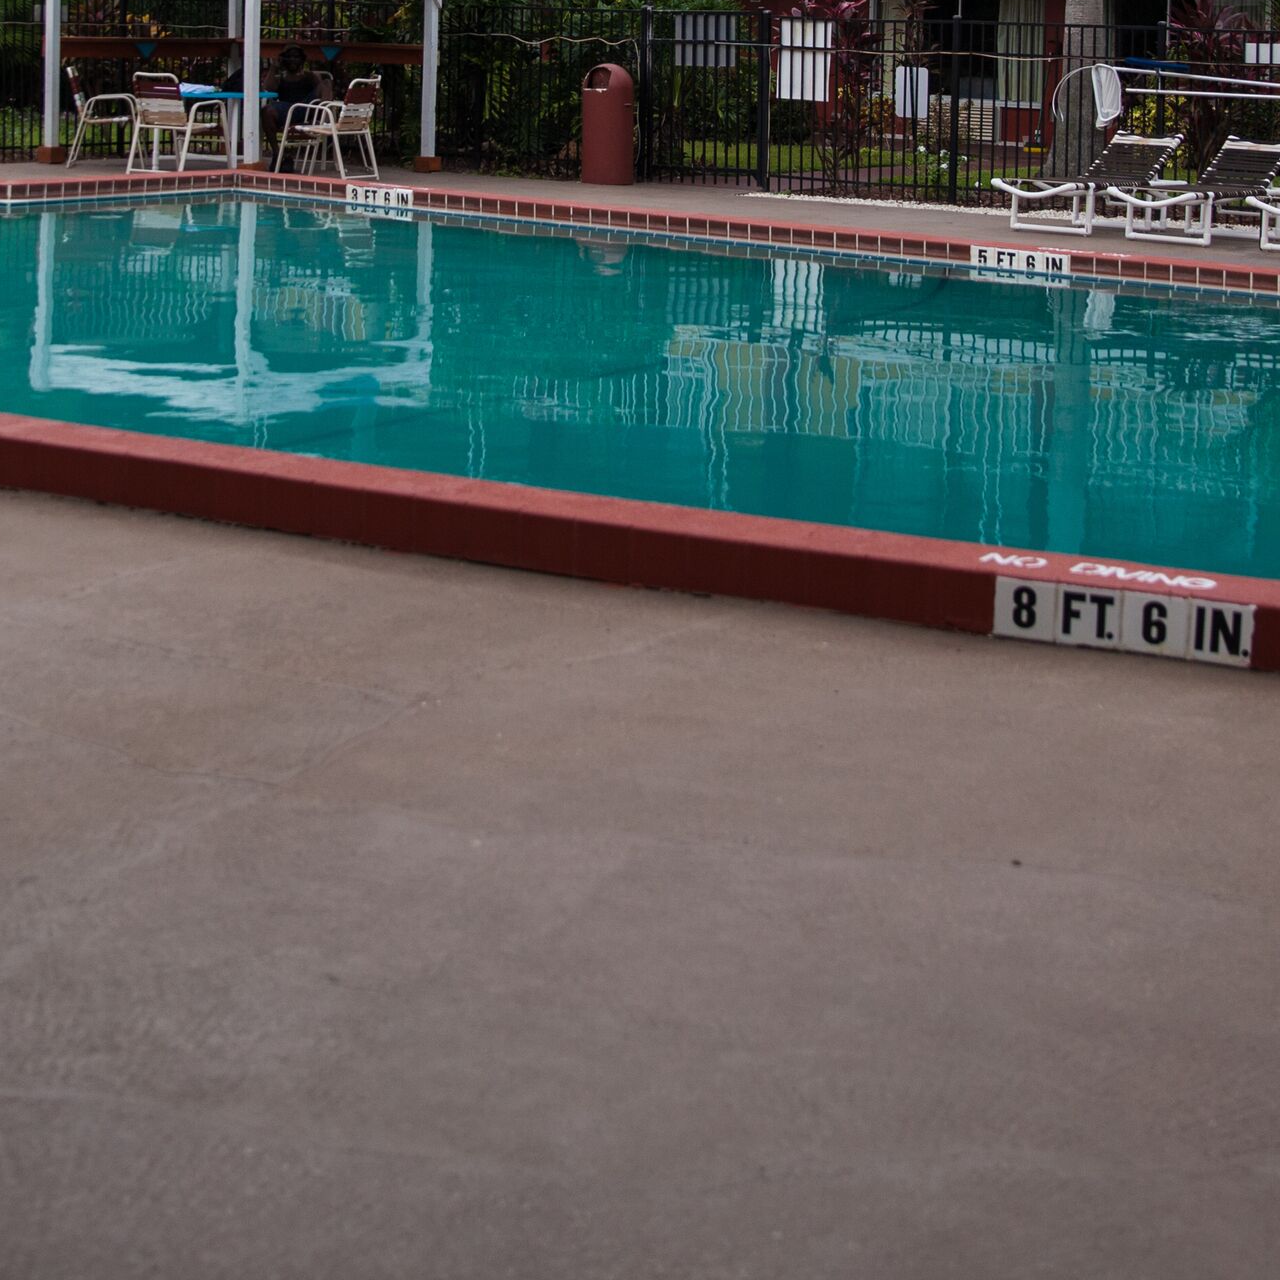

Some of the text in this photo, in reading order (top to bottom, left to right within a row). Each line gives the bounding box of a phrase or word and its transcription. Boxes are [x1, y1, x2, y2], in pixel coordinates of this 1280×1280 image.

[351, 188, 358, 202] 3
[978, 249, 987, 264] 5
[979, 552, 1217, 590] NO DIVING
[1012, 586, 1249, 657] 8 FT. 6 IN.
